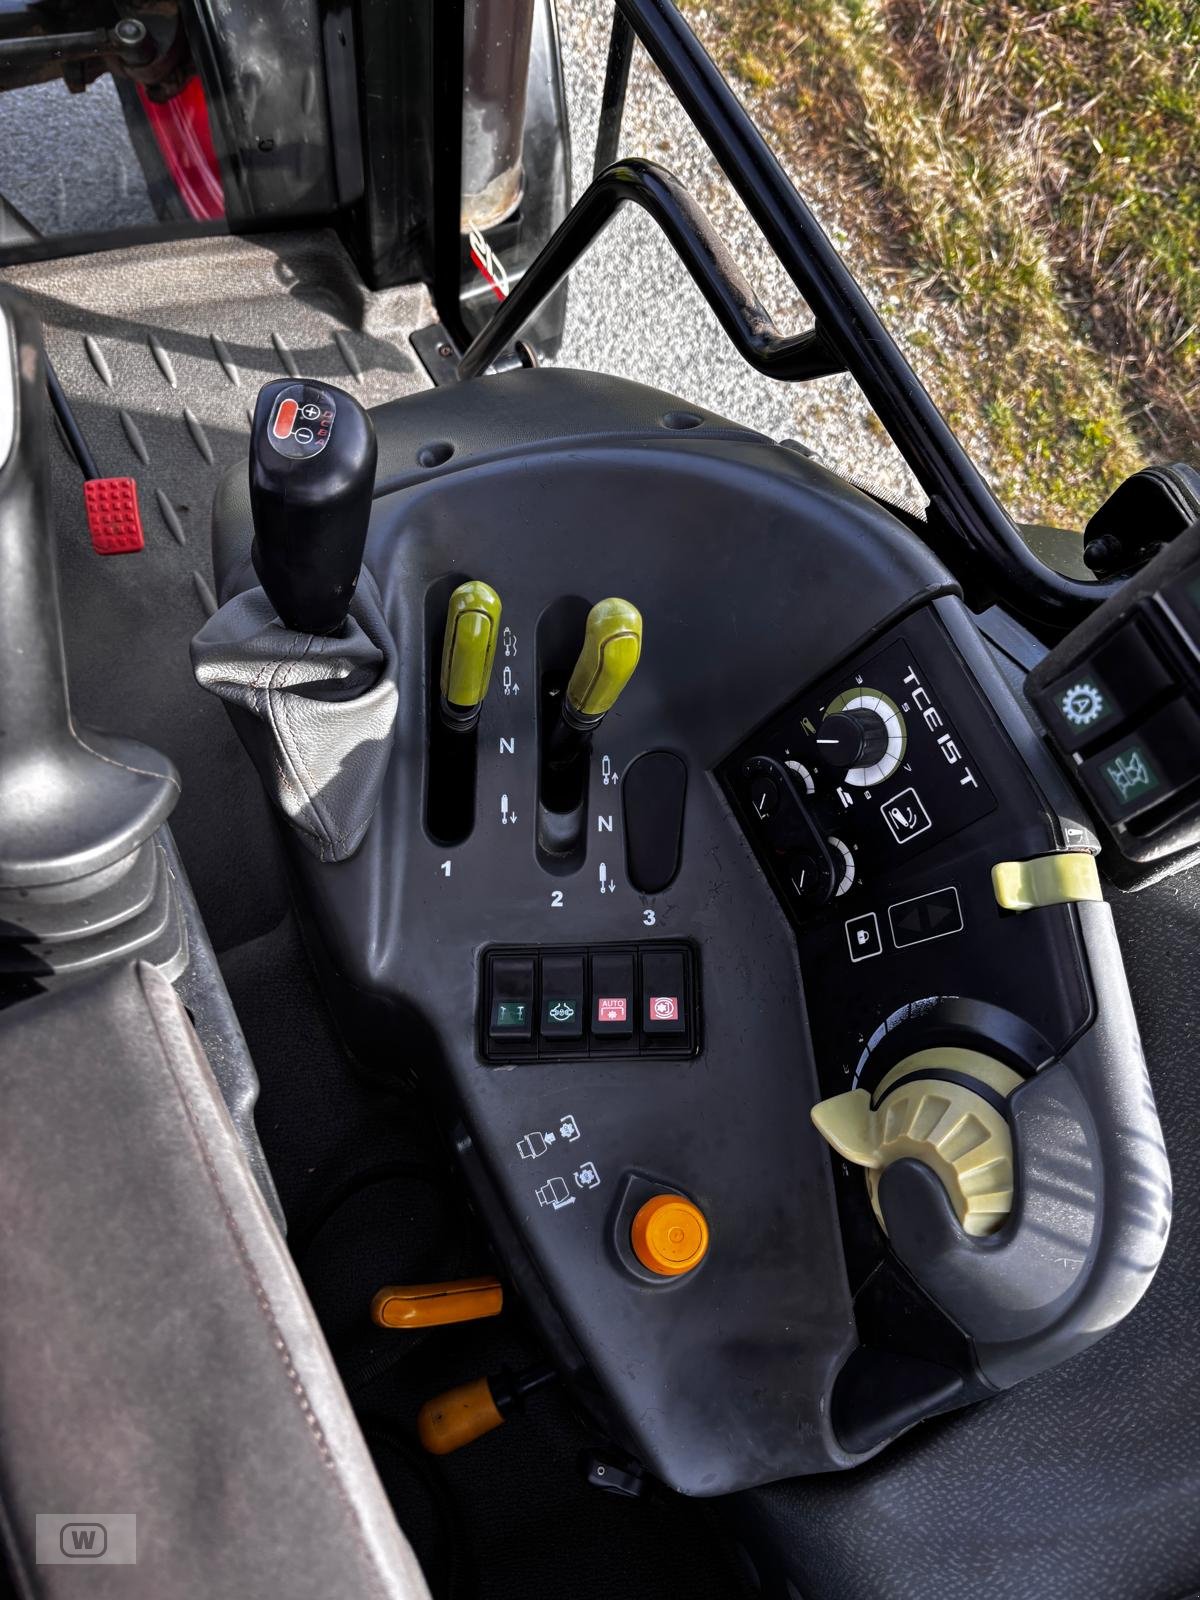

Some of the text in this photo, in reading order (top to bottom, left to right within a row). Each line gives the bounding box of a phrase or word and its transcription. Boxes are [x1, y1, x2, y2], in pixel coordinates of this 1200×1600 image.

[903, 665, 944, 732] TCE
[959, 766, 979, 788] T
[499, 737, 515, 754] N
[598, 815, 613, 832] N
[440, 860, 451, 877] 1
[550, 890, 564, 908] 2
[642, 909, 657, 926] 3
[602, 999, 624, 1008] AUTO
